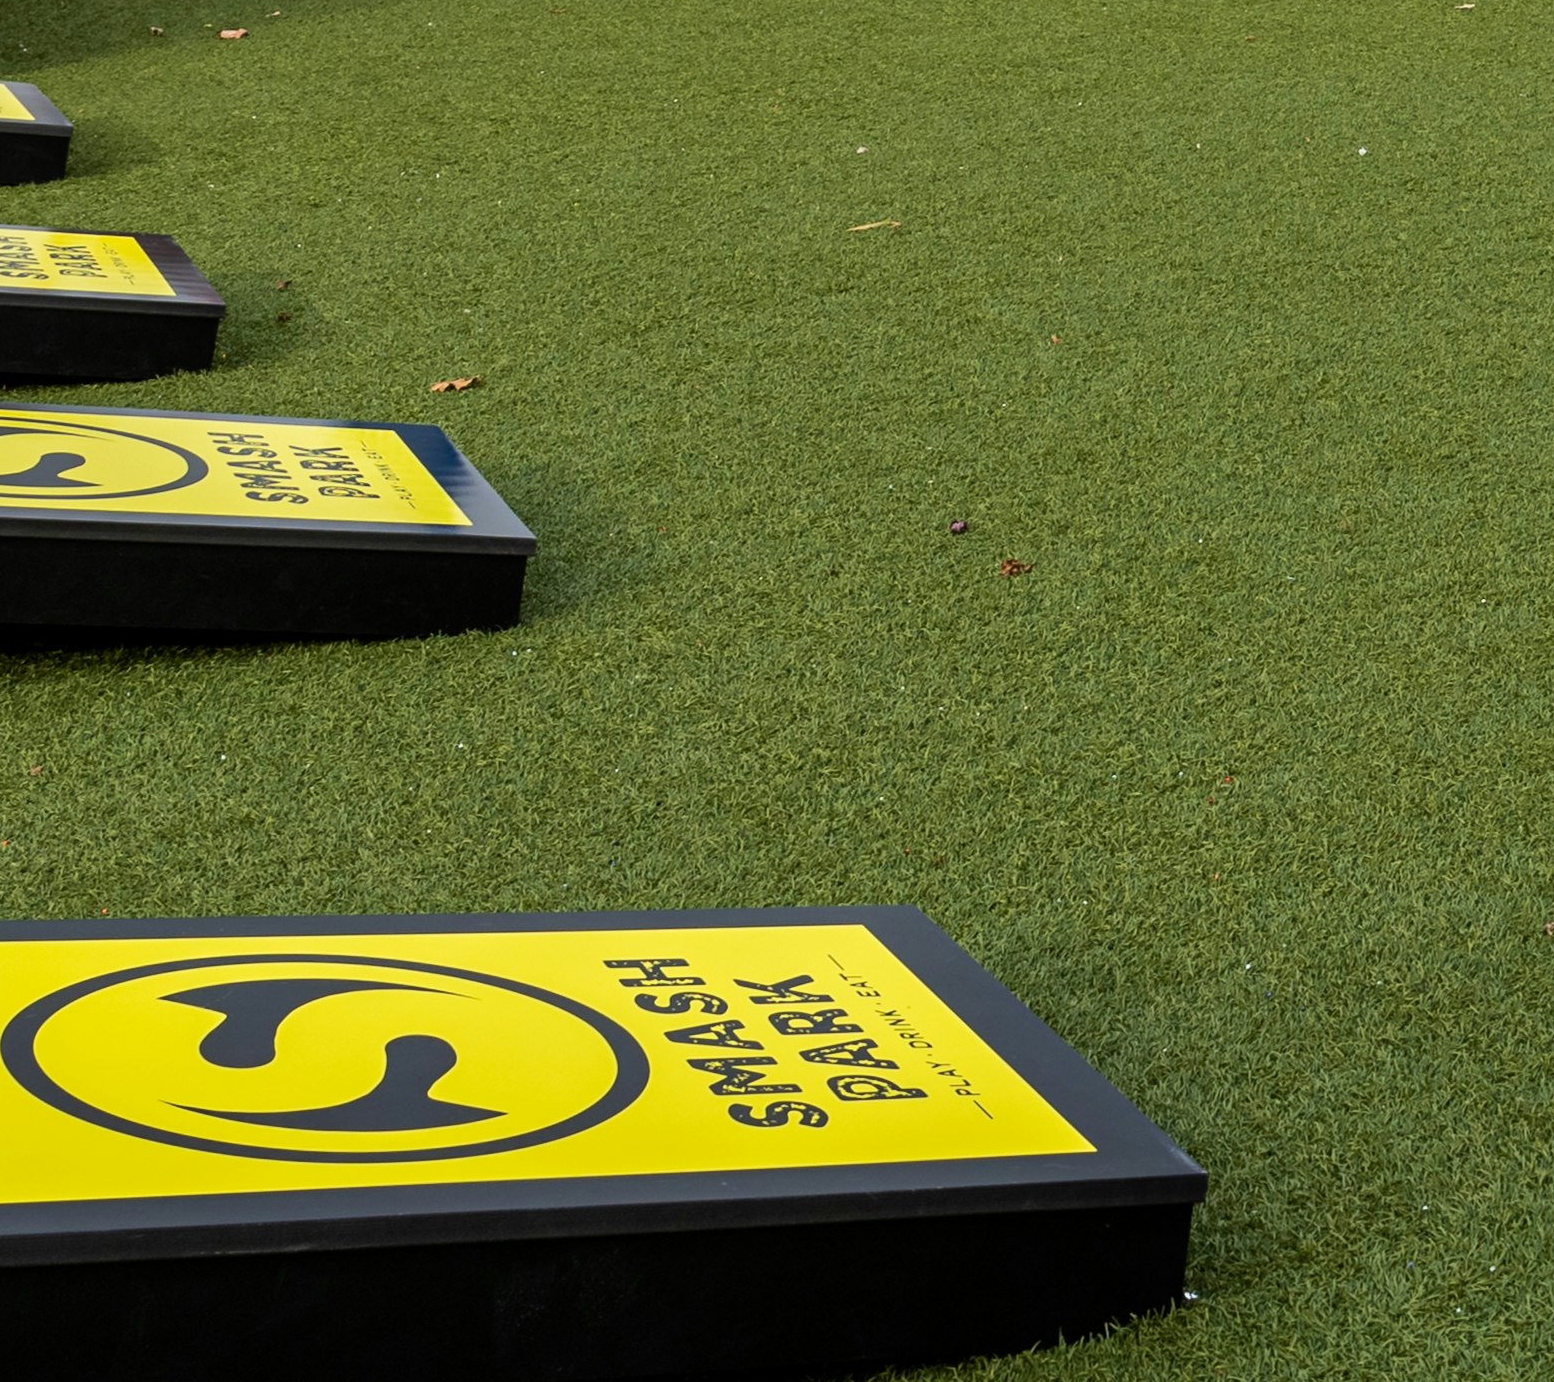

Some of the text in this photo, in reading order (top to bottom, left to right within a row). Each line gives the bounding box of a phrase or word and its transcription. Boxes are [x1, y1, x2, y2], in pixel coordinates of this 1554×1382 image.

[43, 243, 108, 278] PARK
[207, 431, 309, 504] SMASH
[288, 444, 381, 499] PARK
[602, 958, 830, 1128] SMASH
[732, 974, 929, 1102] PARK
[839, 972, 976, 1098] PLAY DRINK EAT
